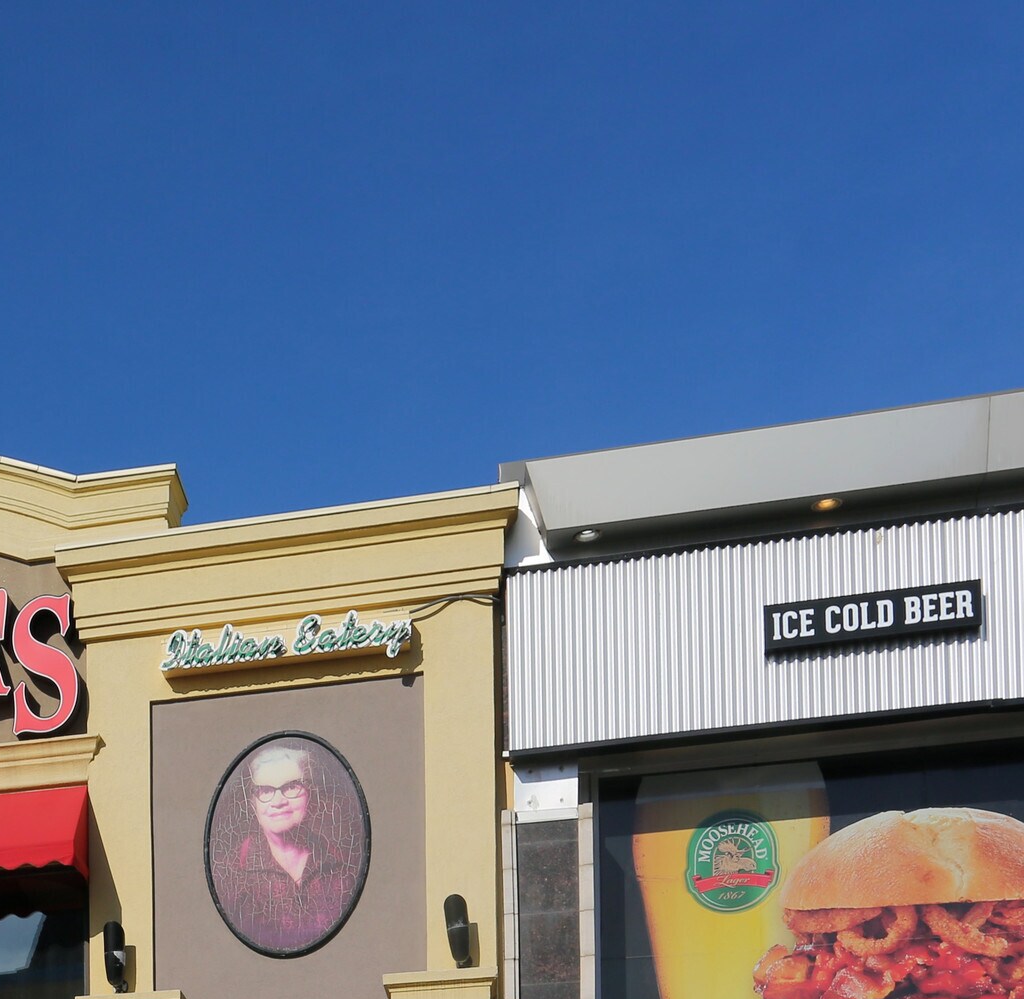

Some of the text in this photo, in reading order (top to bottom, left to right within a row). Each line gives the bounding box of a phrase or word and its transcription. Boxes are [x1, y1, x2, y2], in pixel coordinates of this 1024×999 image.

[772, 589, 975, 641] ICE COLD BEER
[160, 610, 413, 671] Italian Eatery
[698, 823, 768, 863] MOOSEHEAD
[717, 875, 751, 889] Lager
[718, 890, 746, 900] 1867
